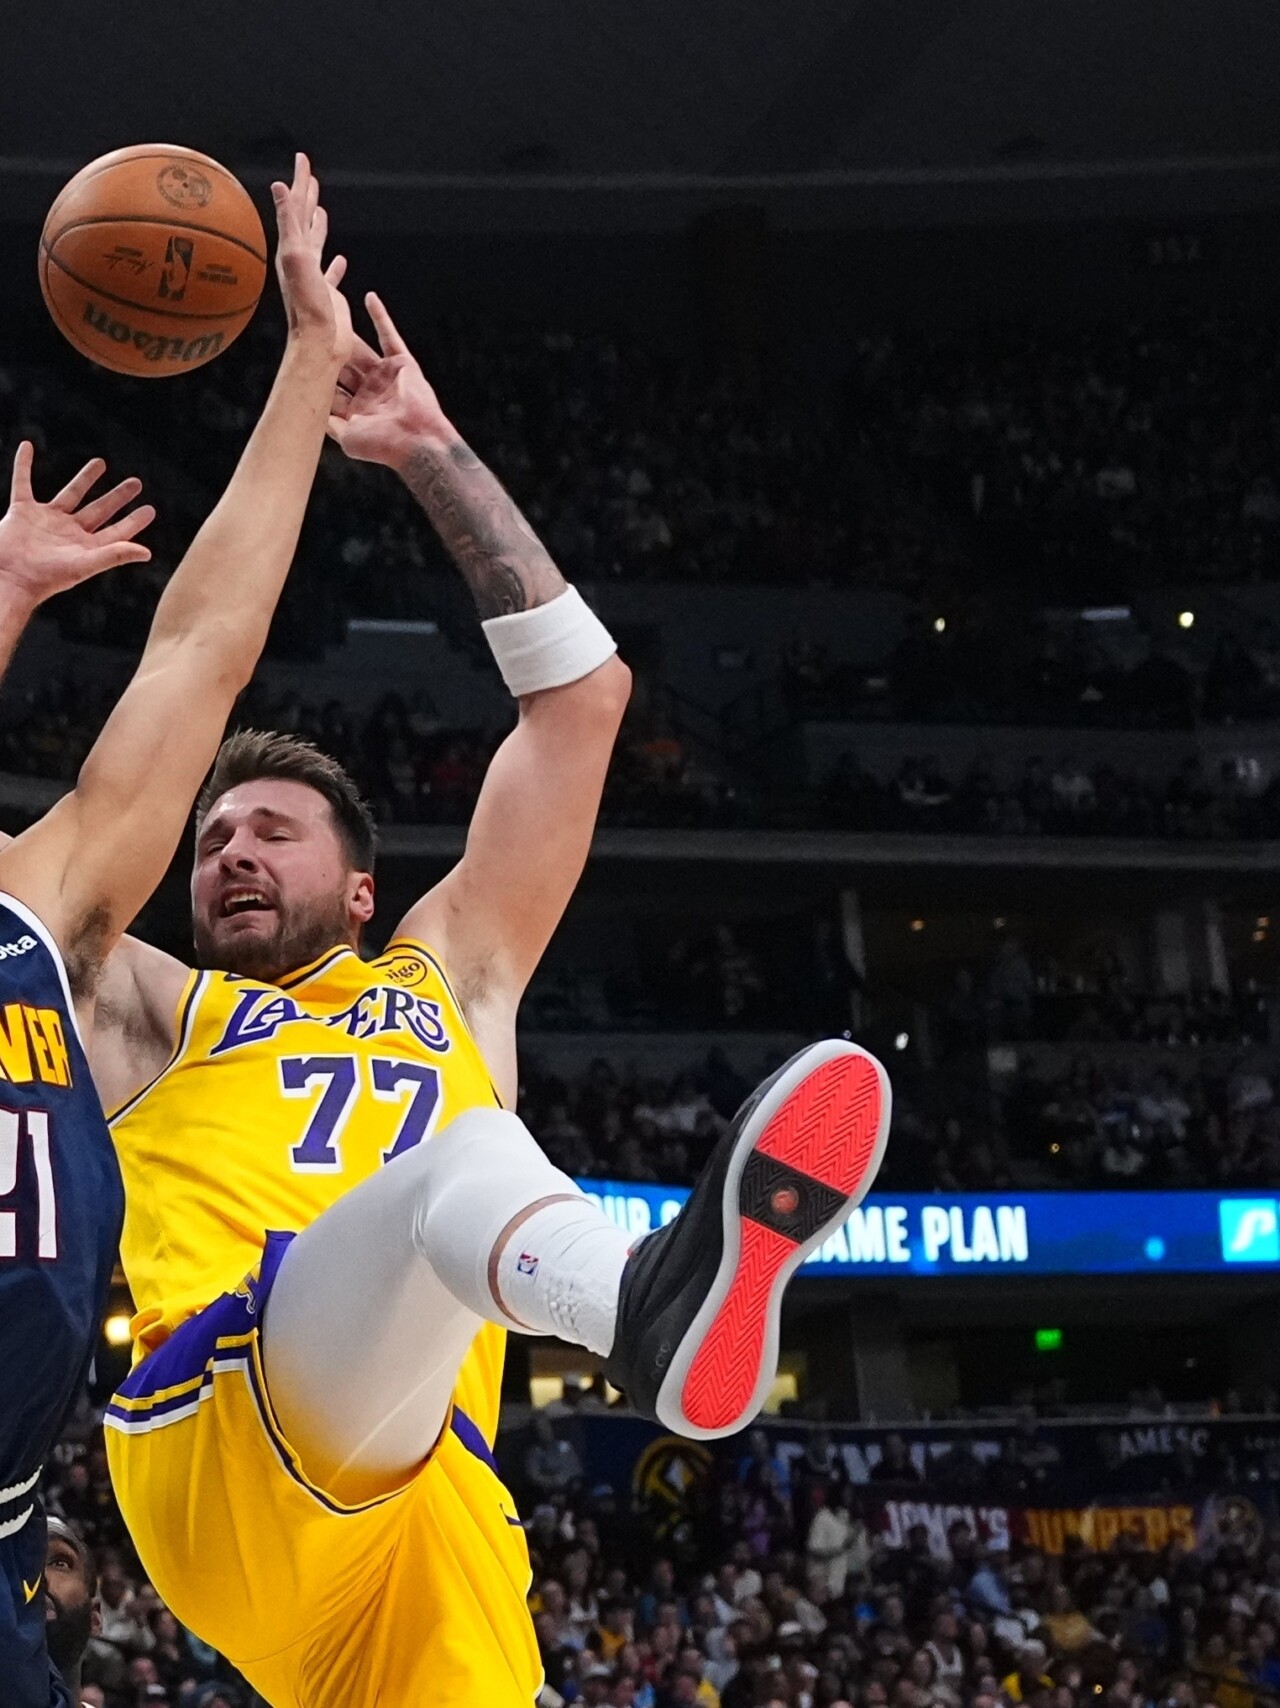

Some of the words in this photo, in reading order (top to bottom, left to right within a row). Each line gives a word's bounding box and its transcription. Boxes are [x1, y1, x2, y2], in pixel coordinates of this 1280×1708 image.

[82, 302, 225, 362] Wilson
[206, 985, 451, 1056] LAERS
[277, 1055, 444, 1174] 77
[804, 1206, 911, 1263] AME
[921, 1206, 1029, 1262] PLAN
